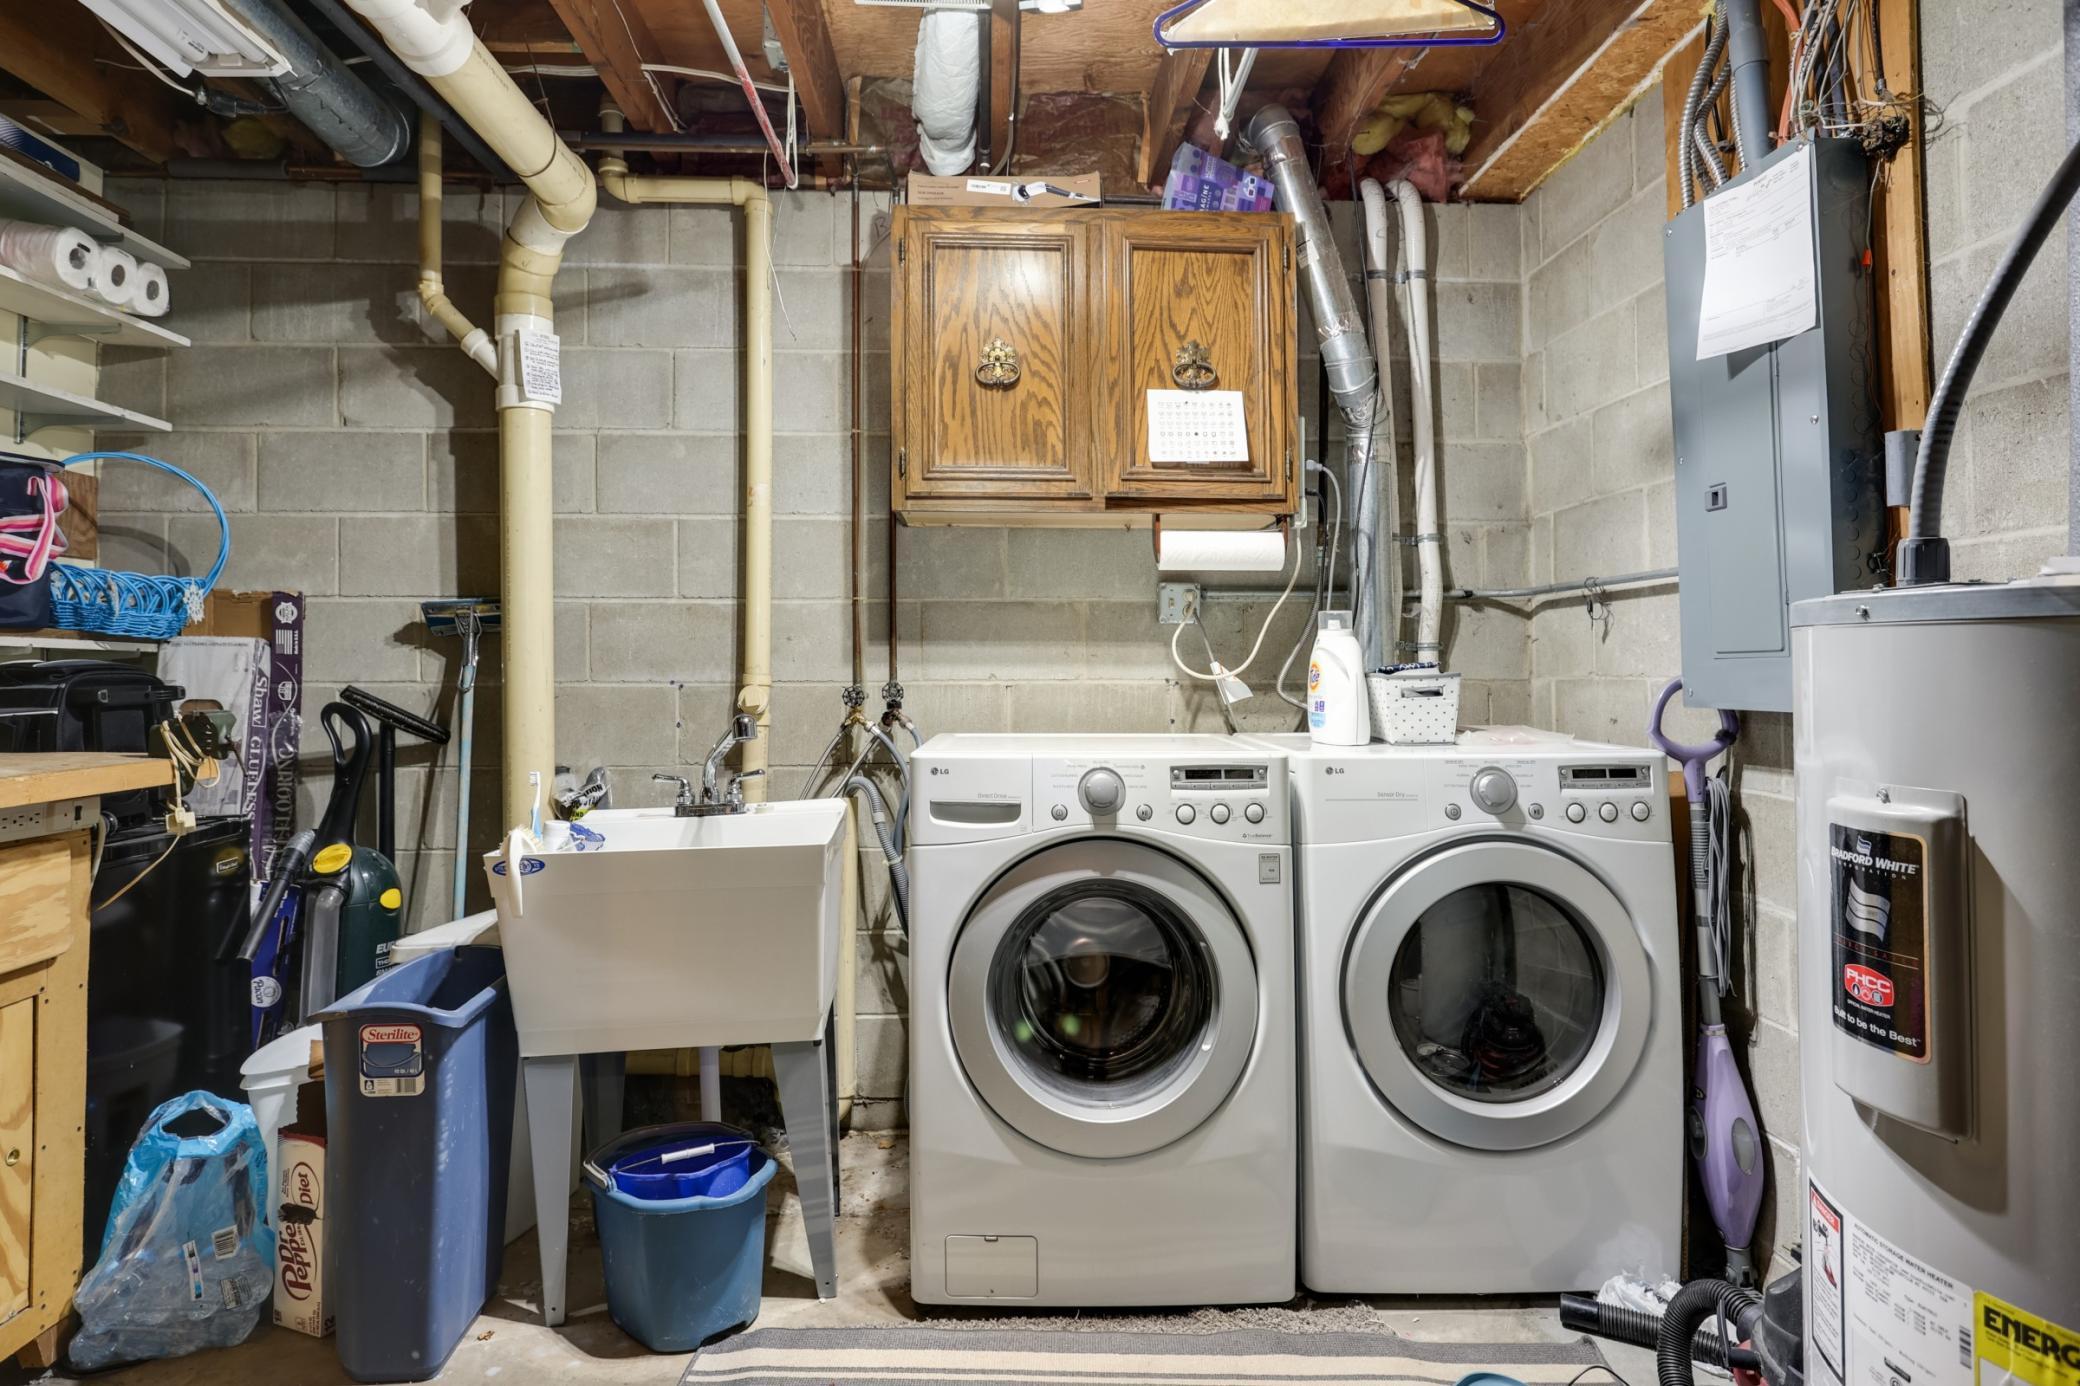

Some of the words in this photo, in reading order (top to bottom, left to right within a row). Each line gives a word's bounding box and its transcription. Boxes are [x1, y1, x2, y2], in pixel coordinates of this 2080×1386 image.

[253, 676, 268, 725] Shaw
[246, 735, 262, 820] GLUELESS
[1831, 845, 1874, 866] BRADFORD
[1875, 857, 1916, 875] WHITE
[1846, 967, 1891, 993] PHCC
[368, 1028, 415, 1040] Sterilite
[1847, 1013, 1855, 1024] to
[1856, 1017, 1868, 1029] be
[1869, 1023, 1886, 1037] the
[1888, 1030, 1917, 1047] Best
[298, 1171, 314, 1205] Diet
[279, 1230, 295, 1264] Dr
[282, 1221, 313, 1298] Peppe
[1905, 1259, 1926, 1274] WATER
[1926, 1271, 1953, 1288] HEATER
